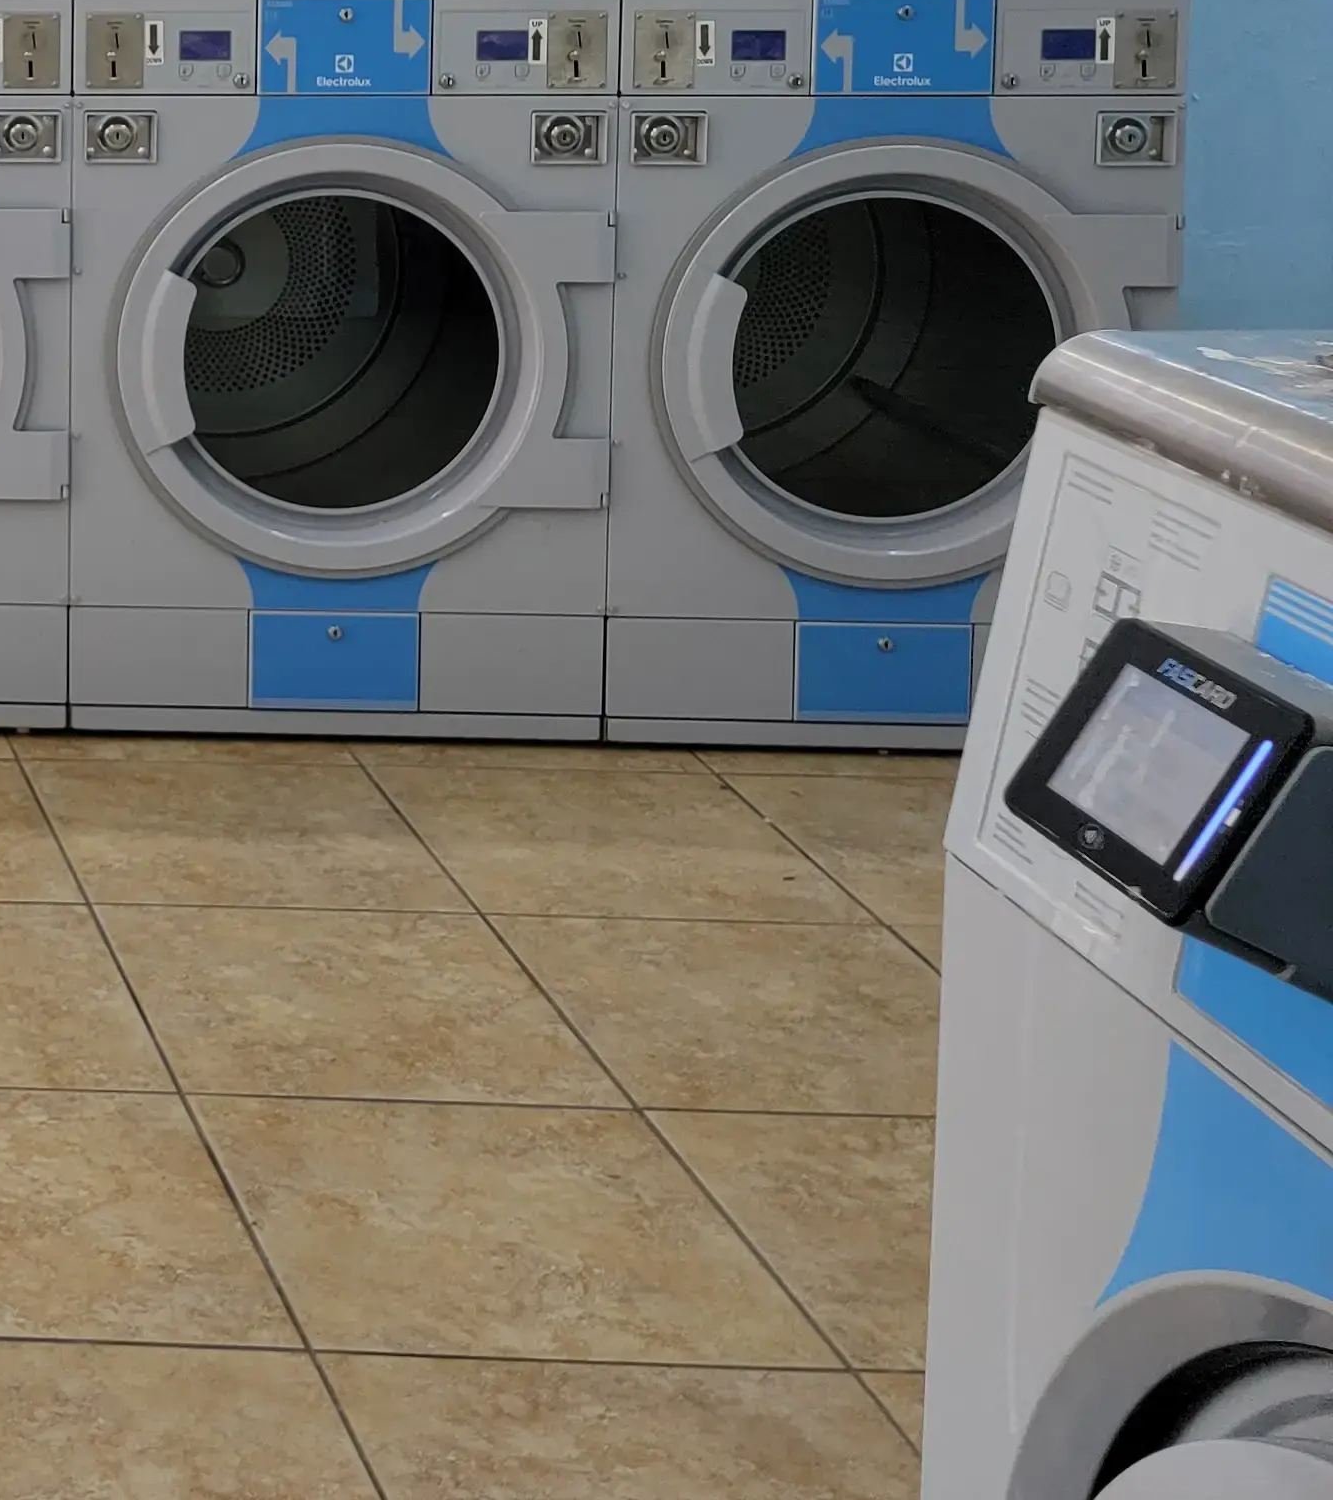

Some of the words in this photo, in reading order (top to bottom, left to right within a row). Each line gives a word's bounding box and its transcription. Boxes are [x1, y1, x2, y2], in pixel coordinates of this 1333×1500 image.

[1099, 19, 1111, 27] UP
[316, 76, 372, 87] Electrolux
[873, 75, 931, 86] Electrolux
